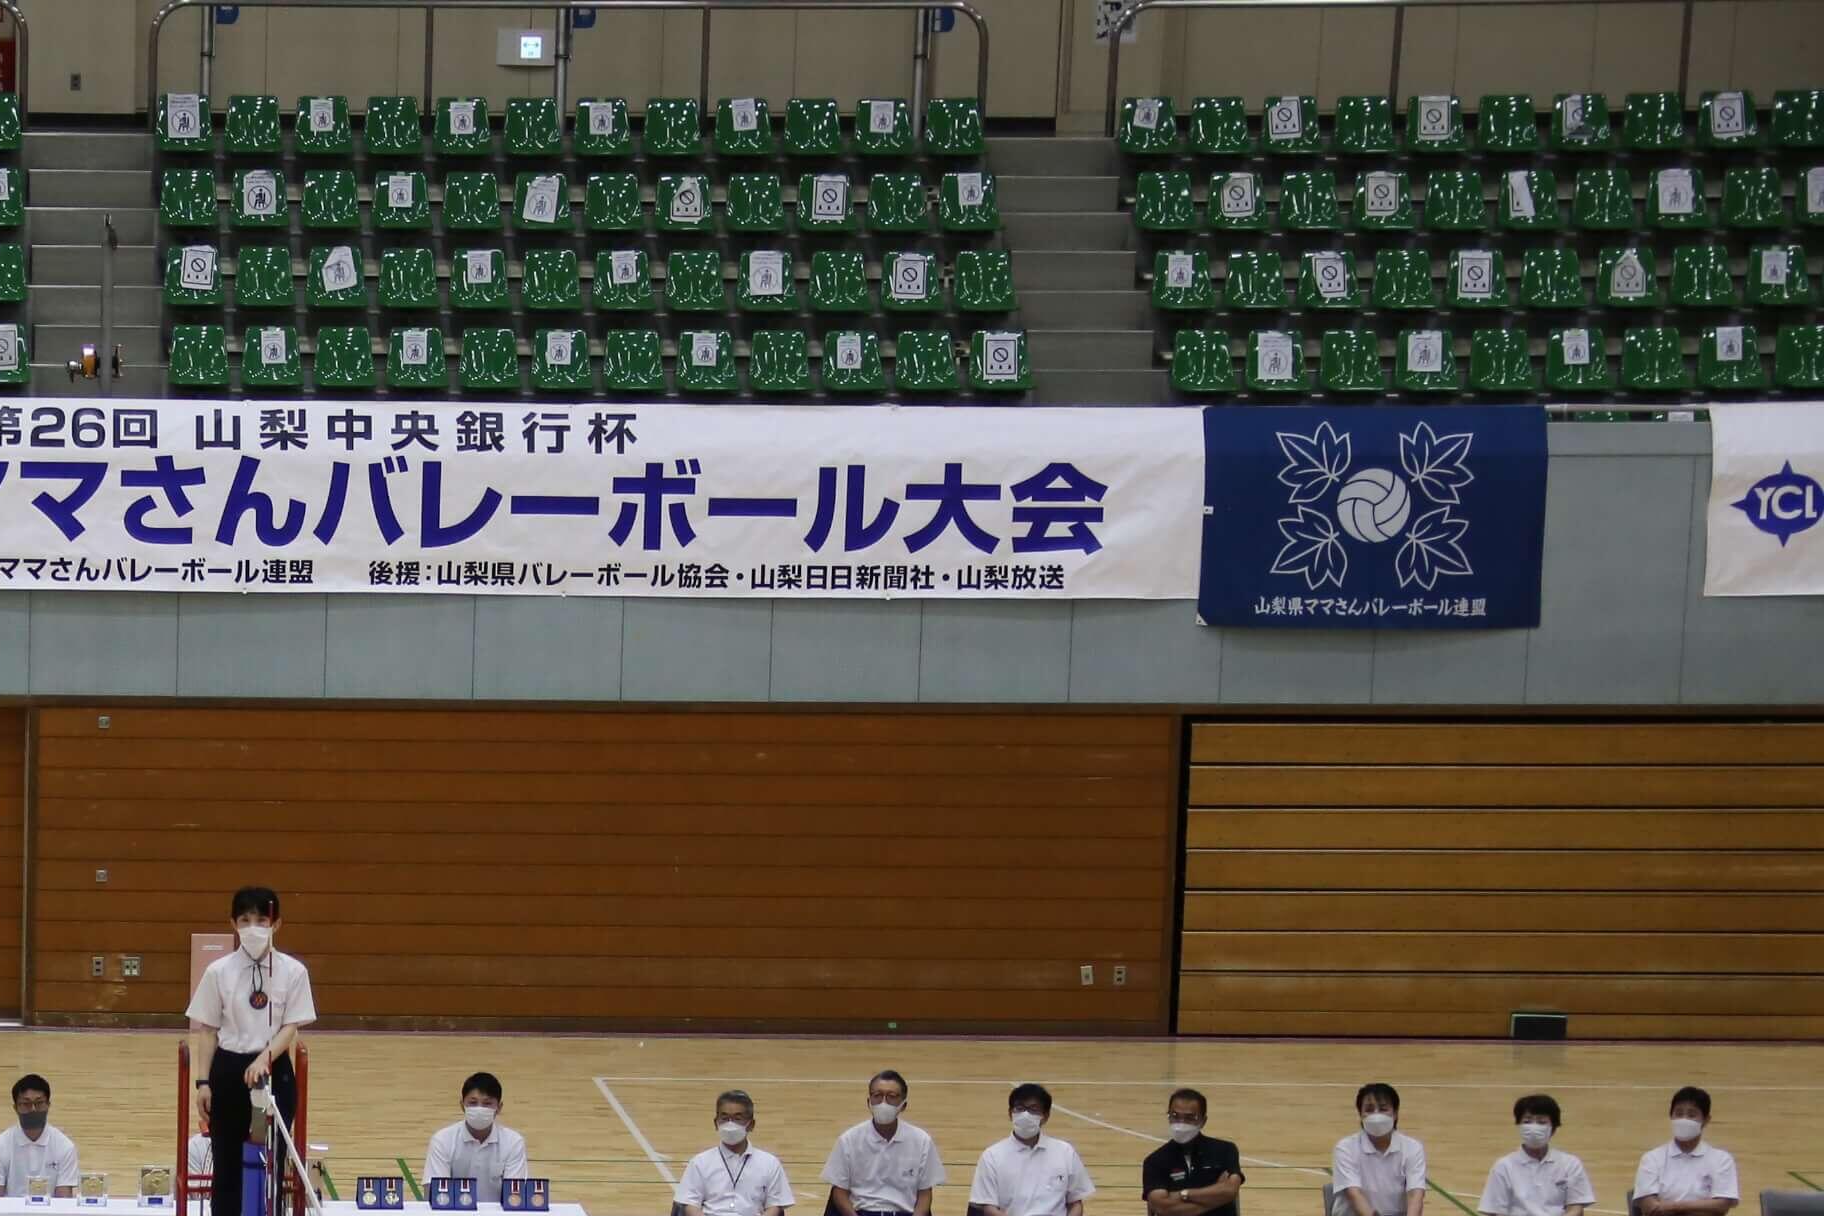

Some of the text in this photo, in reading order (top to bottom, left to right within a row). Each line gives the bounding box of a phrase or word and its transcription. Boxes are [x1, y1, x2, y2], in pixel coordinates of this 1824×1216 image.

[194, 408, 638, 455] 山梨中央銀行杯
[1754, 484, 1818, 520] YCL
[1254, 596, 1487, 617] 山梨県ママさんバレーボール連盟
